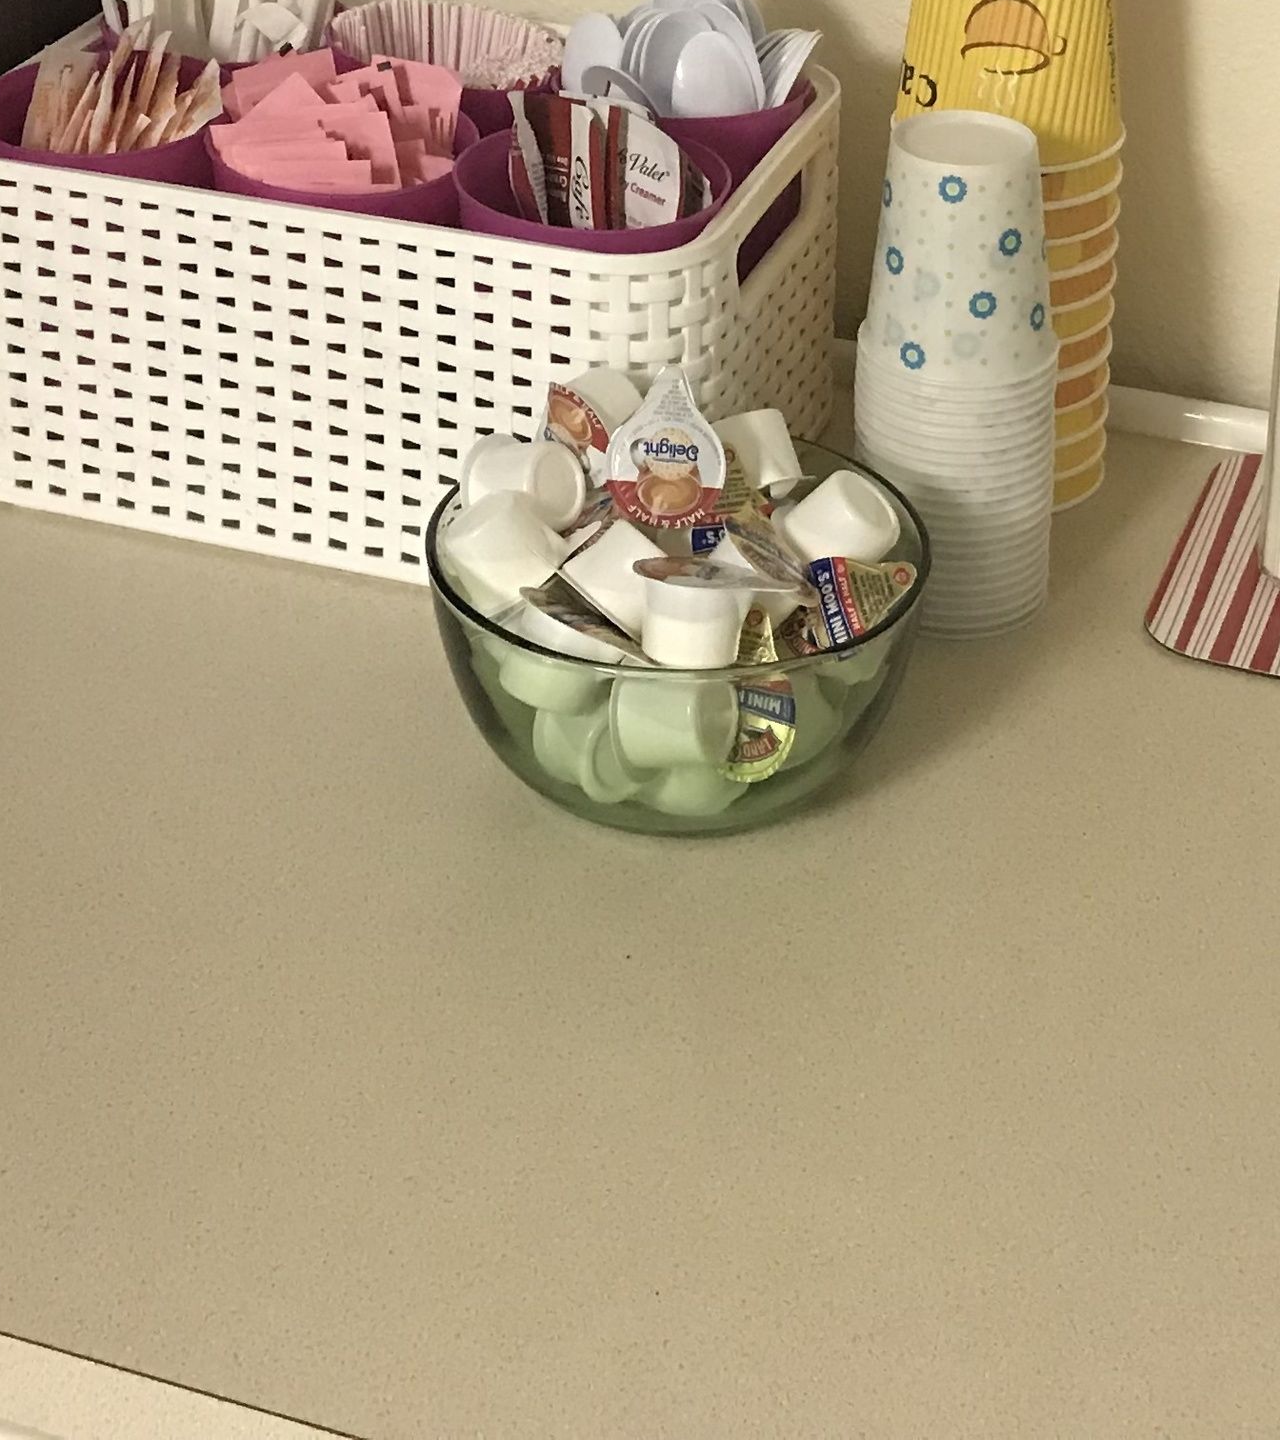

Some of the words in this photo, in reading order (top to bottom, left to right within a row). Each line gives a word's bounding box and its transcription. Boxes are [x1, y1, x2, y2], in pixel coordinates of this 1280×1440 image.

[629, 153, 665, 182] Valet
[630, 182, 667, 206] Creamer
[643, 437, 700, 462] Delight
[626, 504, 659, 527] HALF
[673, 508, 706, 530] HALF
[747, 692, 782, 716] MINI
